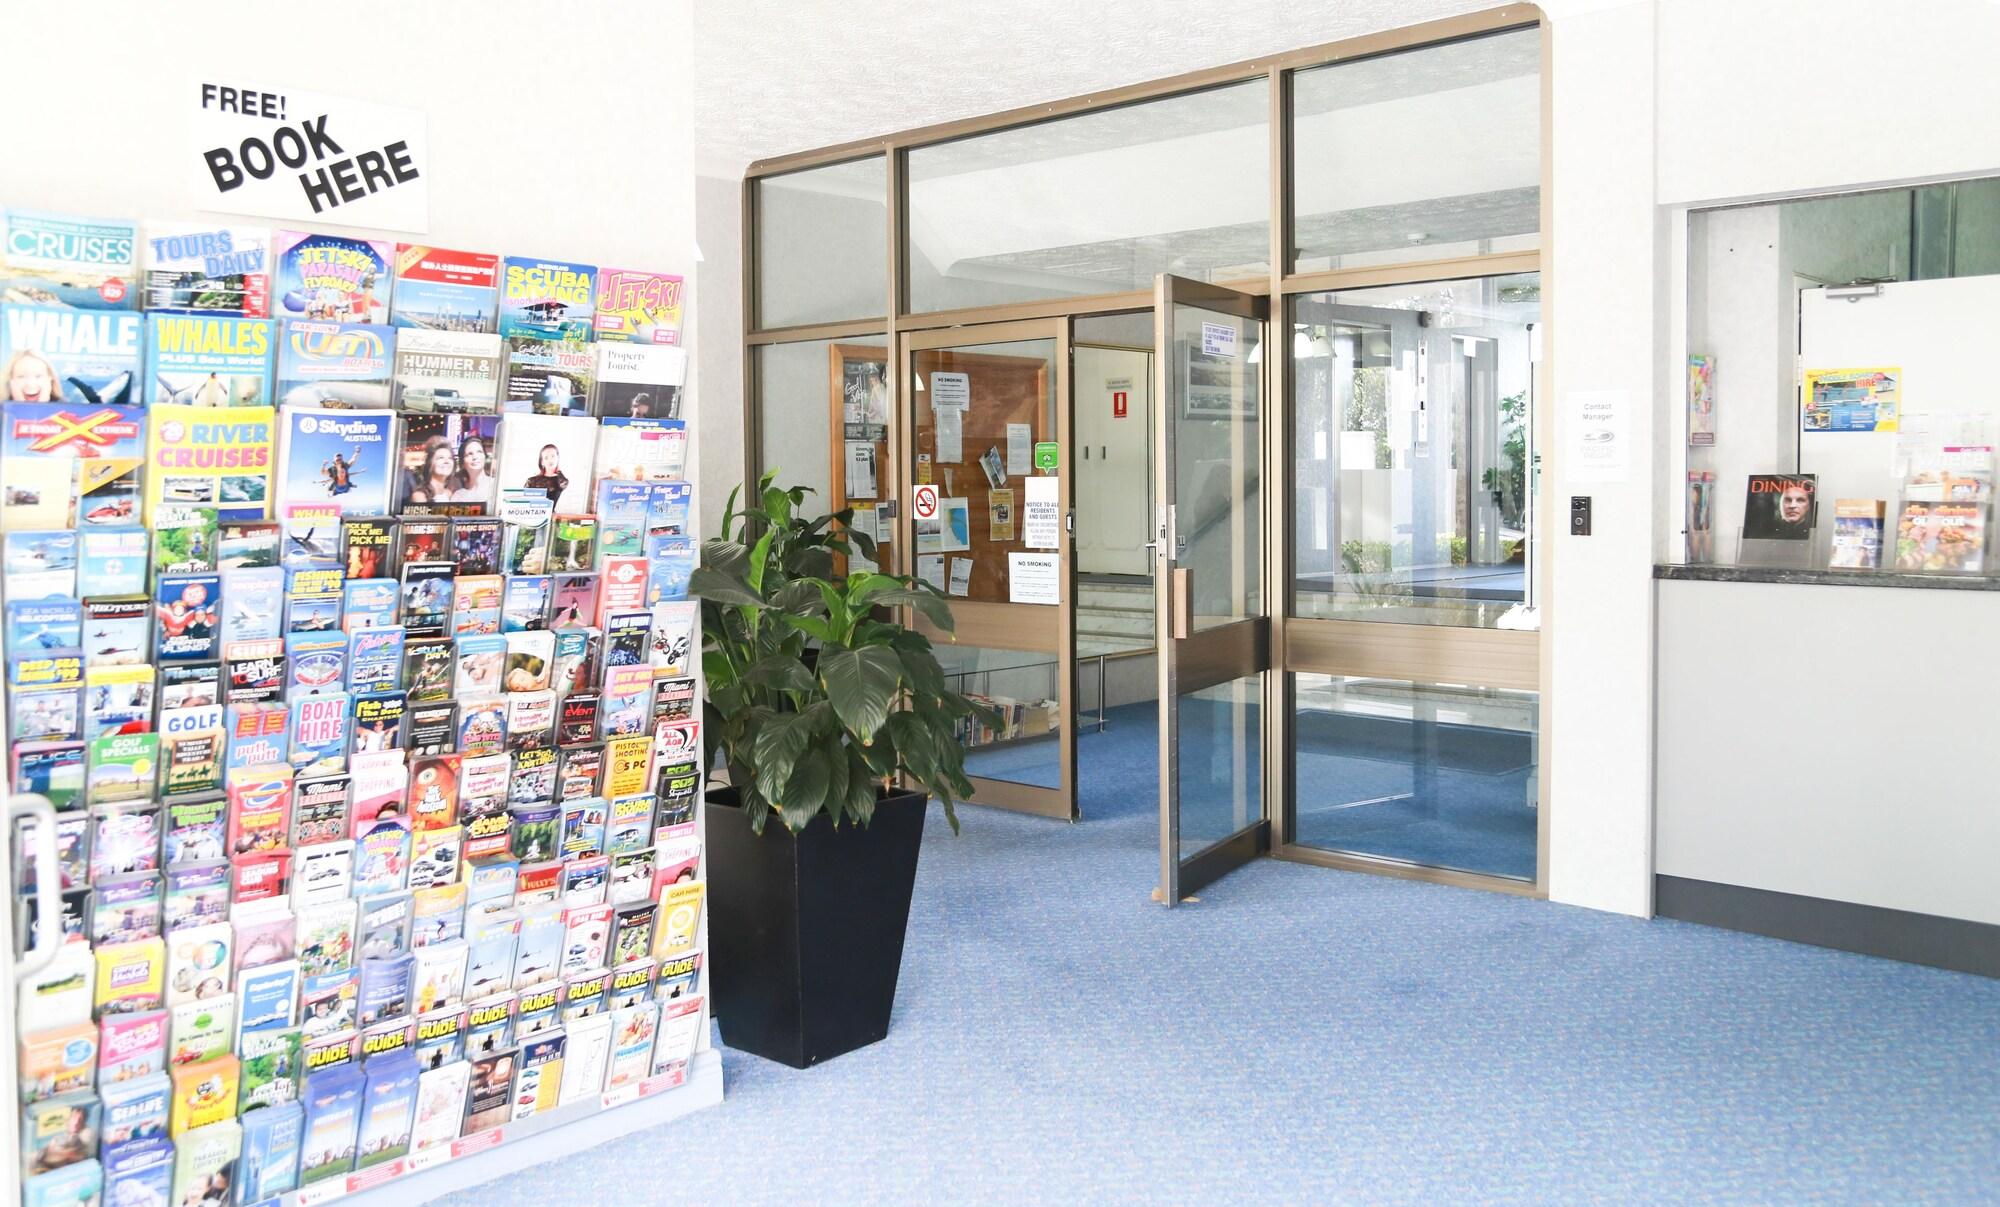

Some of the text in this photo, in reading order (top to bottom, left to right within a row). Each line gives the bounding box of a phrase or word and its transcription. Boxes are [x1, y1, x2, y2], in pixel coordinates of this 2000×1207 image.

[202, 83, 286, 120] FREE!
[203, 114, 344, 193] BOOK
[299, 140, 420, 214] HERE
[9, 229, 131, 265] CRUISES
[152, 230, 233, 263] TOURS
[204, 250, 265, 278] DAILY
[507, 265, 590, 289] SCUBA
[507, 282, 589, 304] DIVING
[8, 308, 139, 355] WHALE
[158, 318, 268, 355] WHALES
[403, 355, 490, 371] HUMMER &
[511, 353, 555, 366] Hinterland
[559, 354, 593, 369] TOURS
[607, 350, 646, 362] Property
[403, 367, 489, 381] PARTY BUS HIRE
[1856, 379, 1876, 389] HIRE
[192, 424, 269, 444] RIVER
[318, 419, 378, 439] Skydive
[343, 433, 382, 443] AUSTRALIA
[157, 447, 269, 468] CRUISES
[1751, 479, 1813, 494] DINING
[508, 508, 547, 517] MOUNTAIN
[349, 528, 383, 536] PICK ME!
[350, 536, 392, 545] PICK ME!
[22, 606, 73, 615] SEA WORLD
[55, 658, 81, 669] SEA
[231, 658, 275, 675] LEARN
[247, 664, 282, 682] SURF
[663, 683, 690, 693] Miami
[301, 700, 345, 722] BOAT
[168, 713, 218, 732] GOLF
[299, 719, 342, 742] HIRE
[112, 737, 142, 748] GOLF
[236, 740, 269, 759] putt
[615, 742, 640, 750] PISTOL
[101, 746, 150, 759] SPECIALS
[247, 748, 279, 765] putt
[306, 781, 344, 796] Miami
[661, 959, 695, 976] GUIDE
[568, 979, 603, 999] GUIDE
[614, 971, 648, 988] GUIDE
[519, 993, 556, 1013] GUIDE
[470, 1006, 507, 1026] GUIDE
[417, 1020, 457, 1040] GUIDE
[363, 1032, 405, 1053] GUIDE
[307, 1044, 349, 1067] GUIDE
[111, 1103, 138, 1122] SEA
